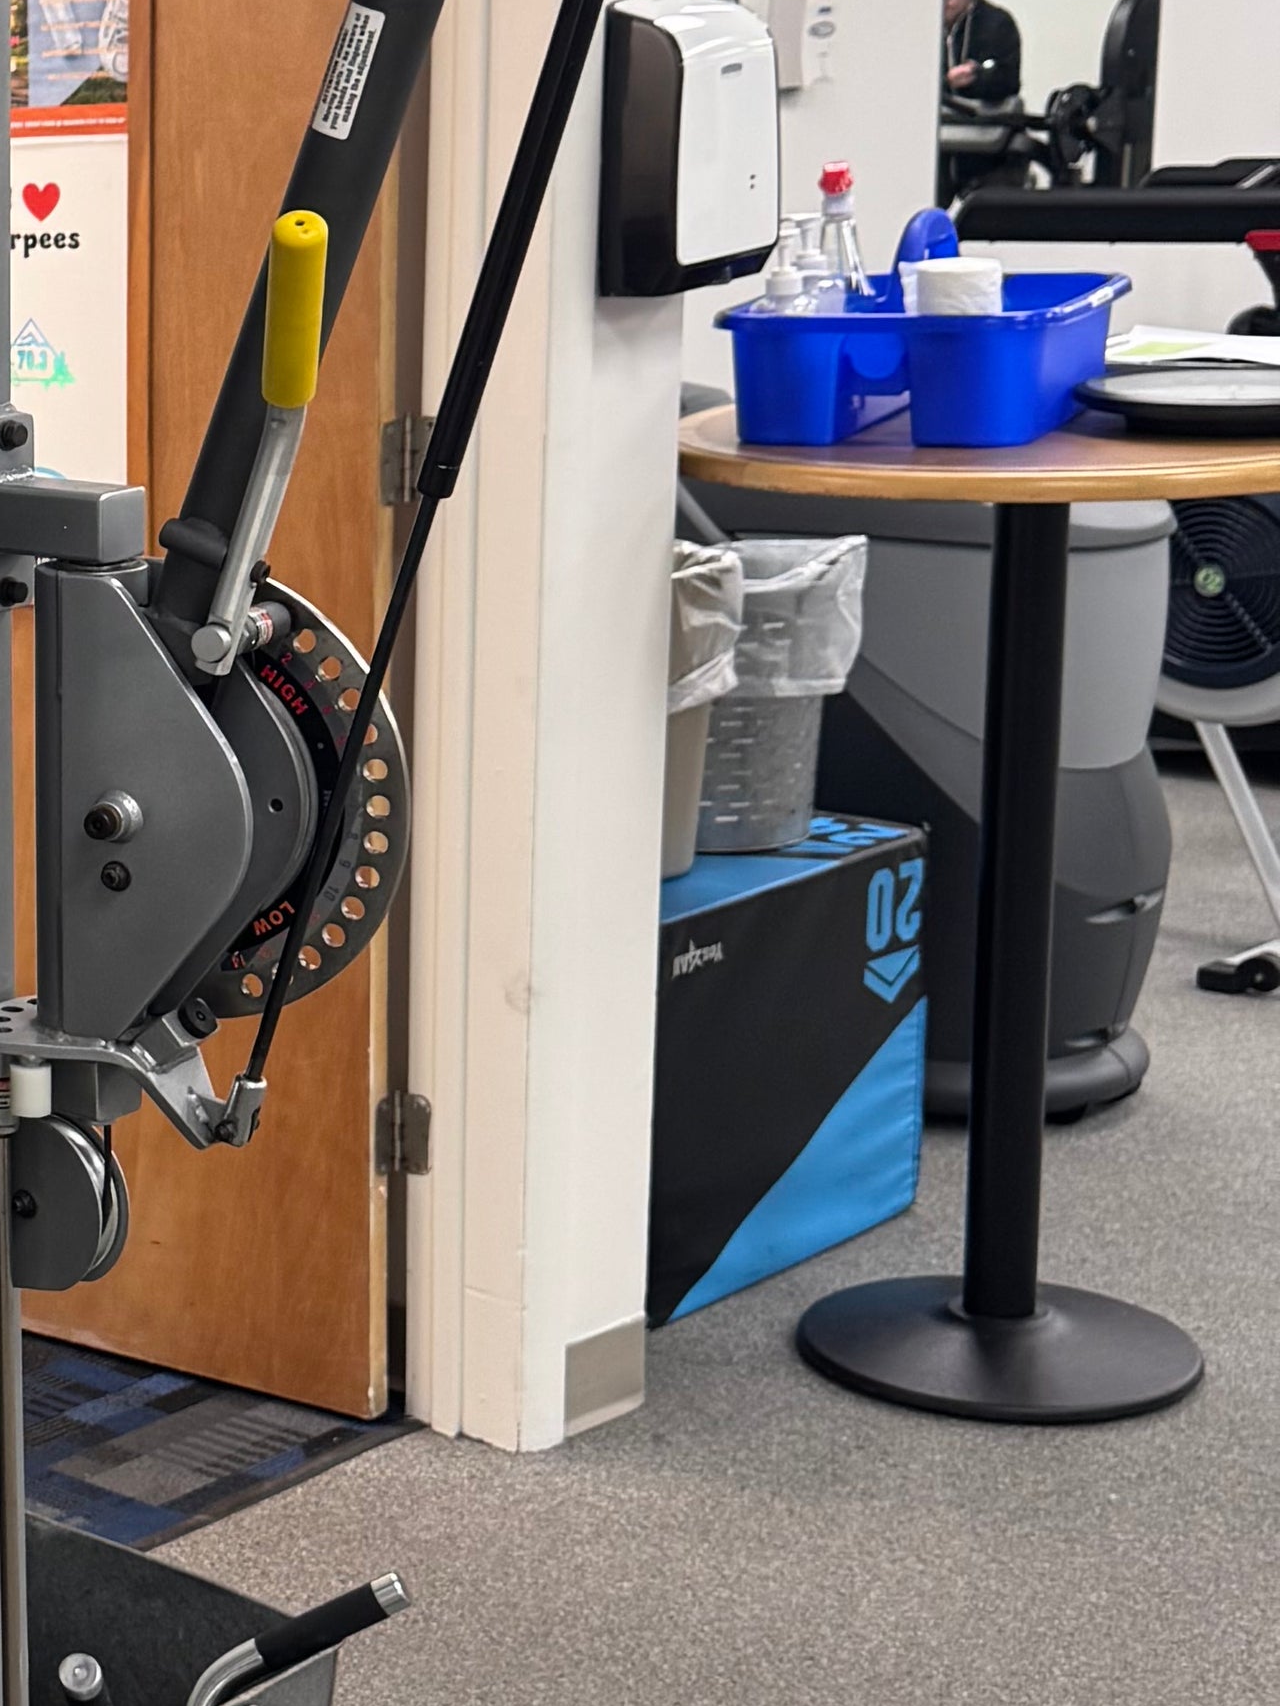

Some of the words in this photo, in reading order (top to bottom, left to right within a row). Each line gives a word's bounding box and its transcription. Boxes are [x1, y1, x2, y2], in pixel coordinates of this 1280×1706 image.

[260, 664, 309, 716] HIGH
[253, 900, 296, 936] LOW
[865, 857, 925, 953] 20
